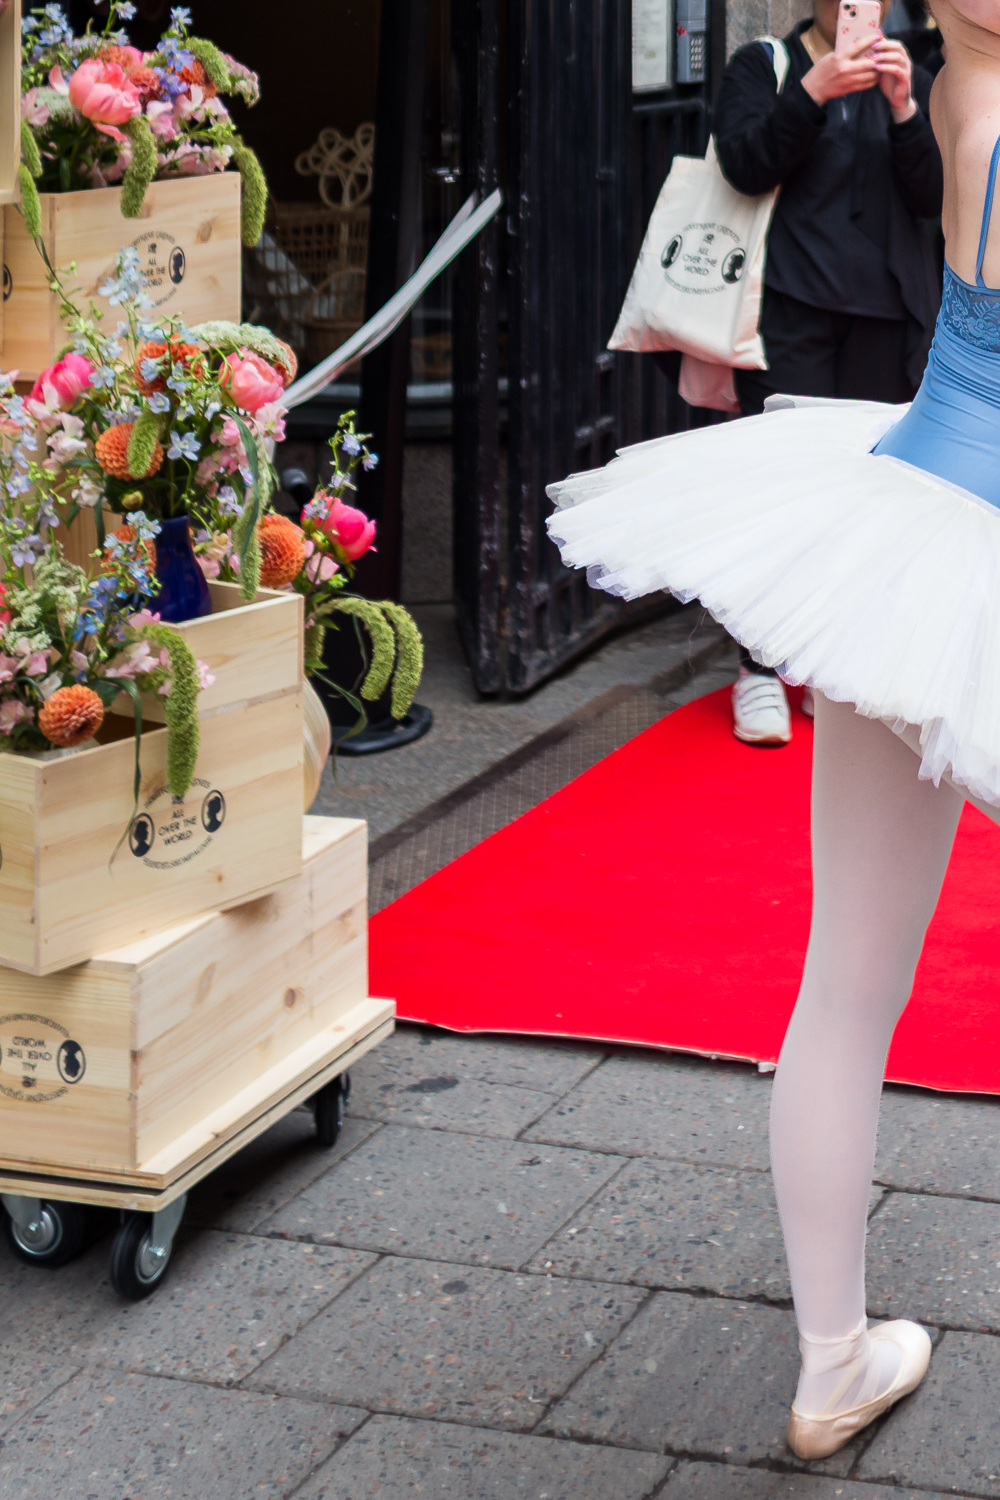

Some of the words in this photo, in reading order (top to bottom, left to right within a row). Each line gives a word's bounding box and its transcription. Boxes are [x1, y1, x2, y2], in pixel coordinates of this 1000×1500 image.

[684, 264, 710, 276] WORLD
[157, 821, 180, 836] OVER
[183, 815, 197, 826] THE
[163, 829, 193, 845] WORLD
